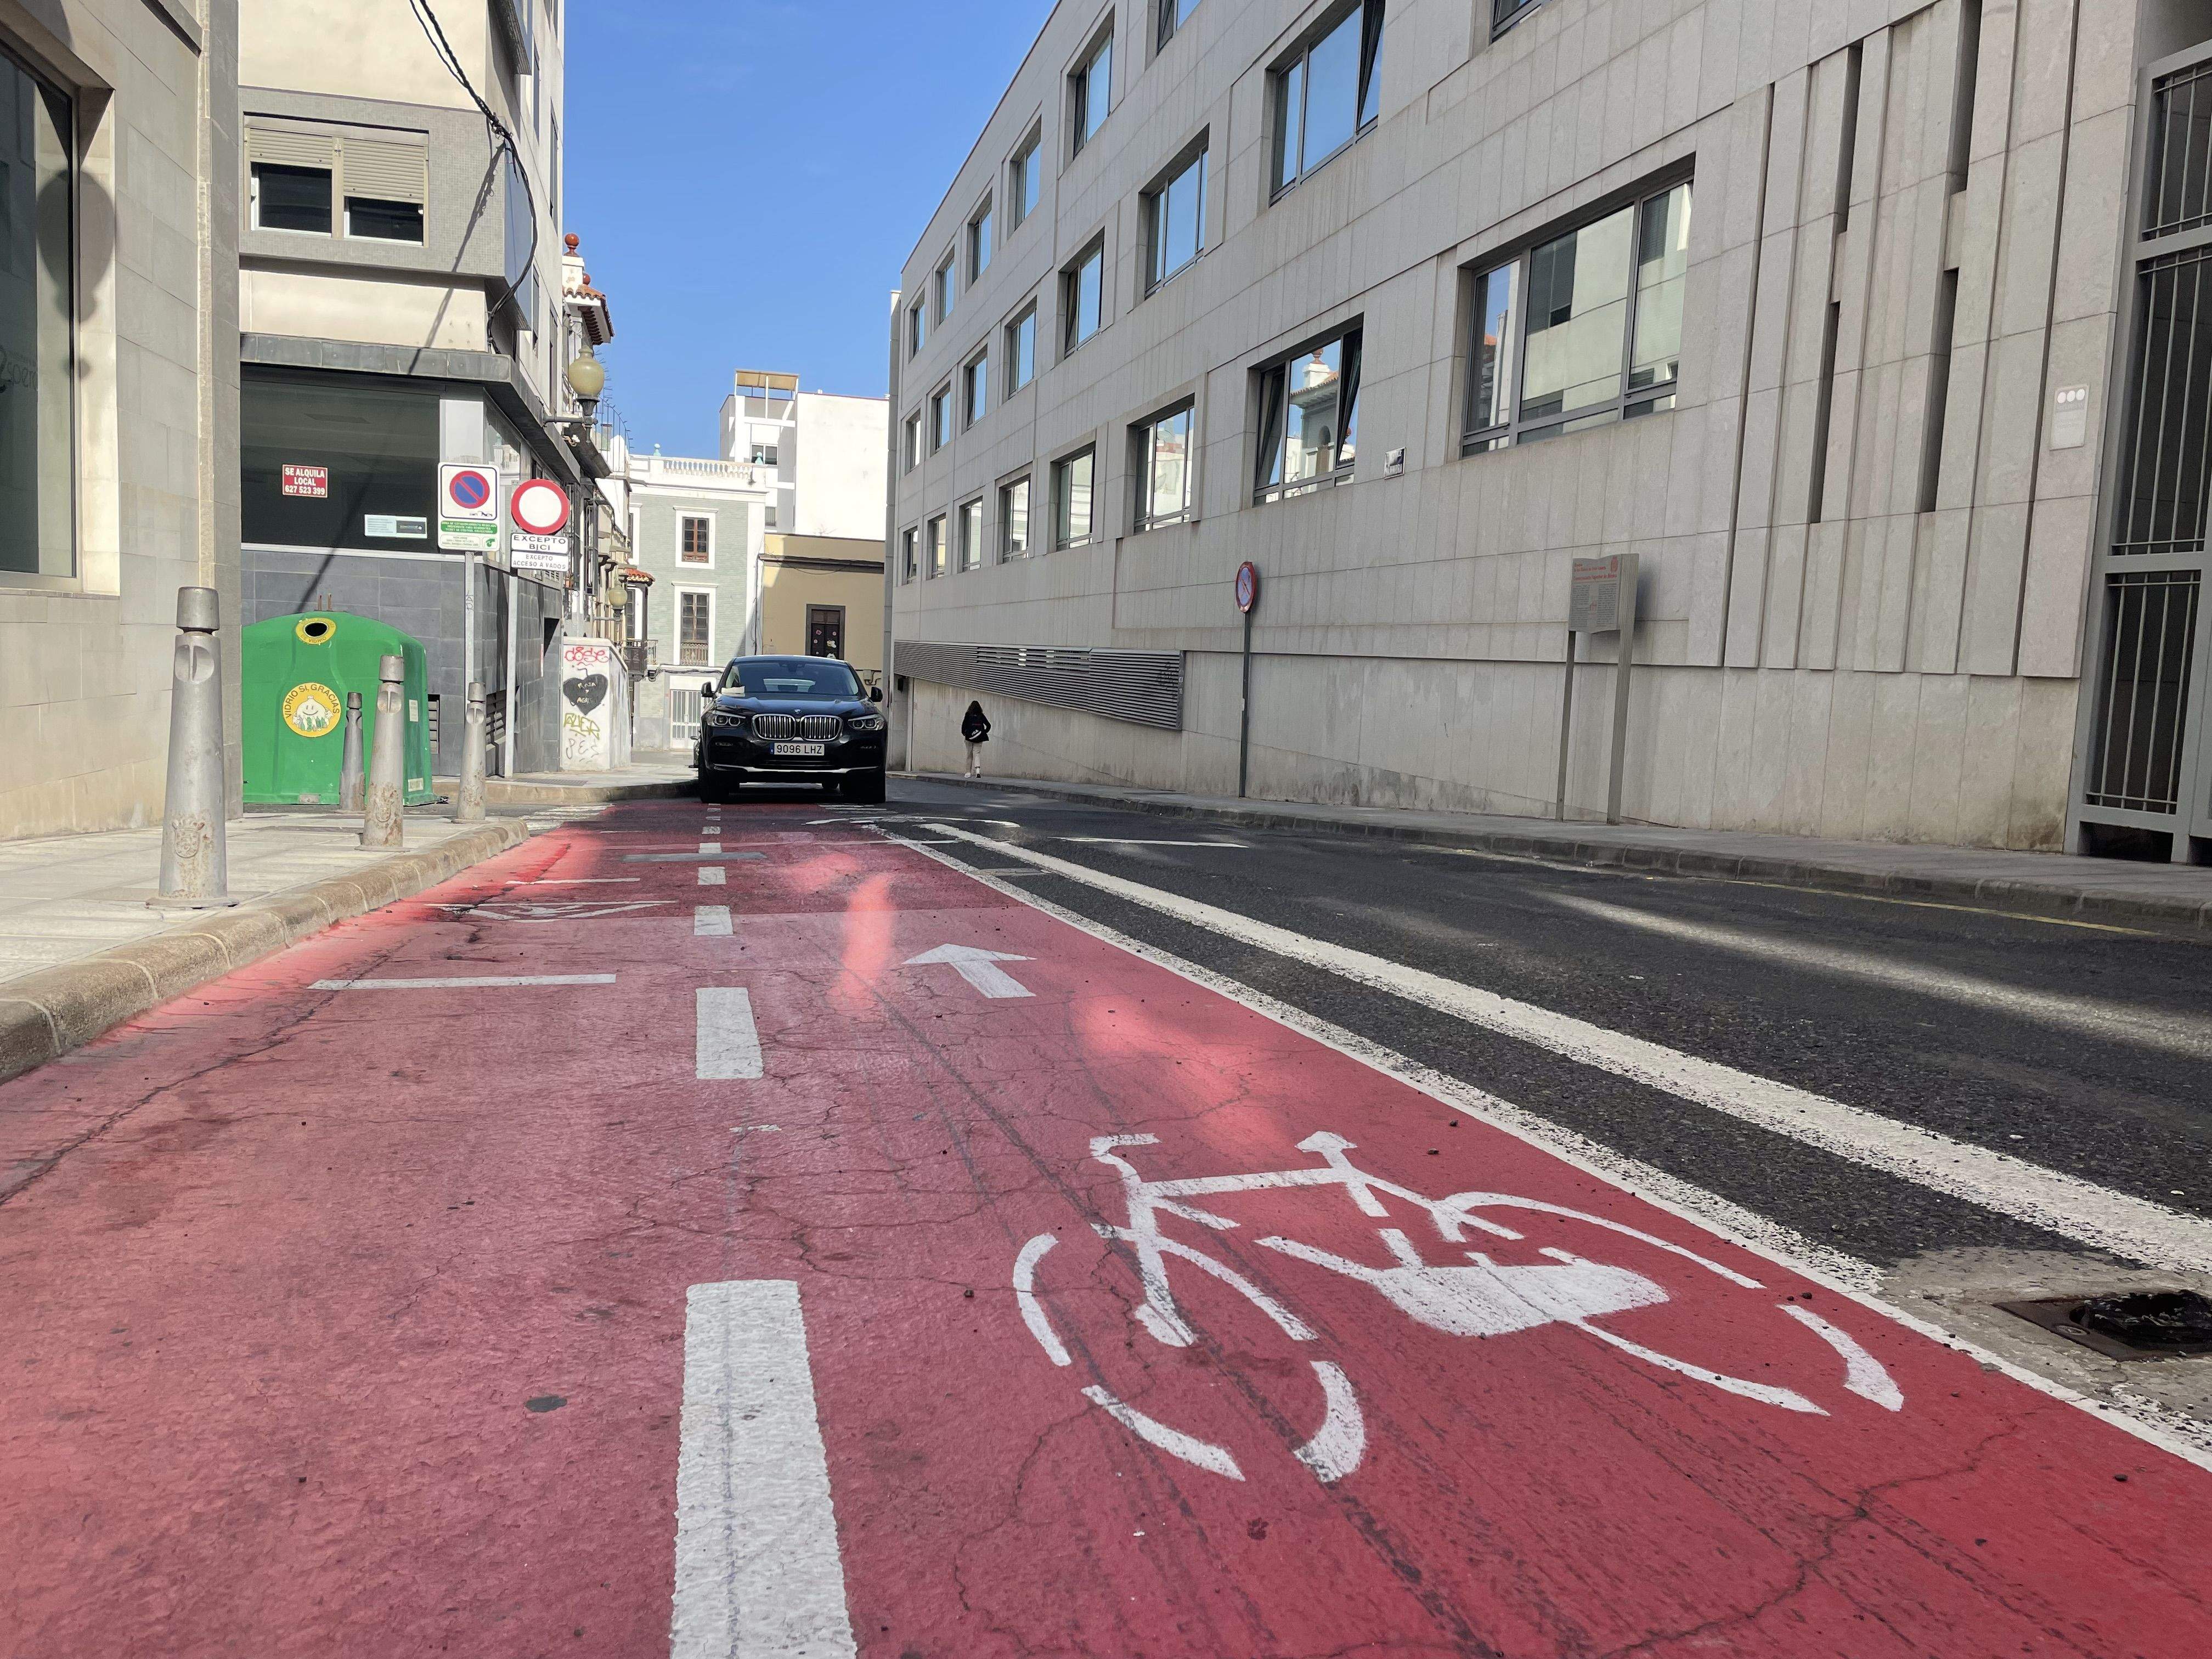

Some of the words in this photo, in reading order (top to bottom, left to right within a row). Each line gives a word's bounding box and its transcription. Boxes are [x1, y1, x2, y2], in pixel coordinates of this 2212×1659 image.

[285, 467, 295, 476] SE
[296, 468, 325, 478] ALQUILA
[294, 477, 316, 486] LOCAL
[285, 485, 298, 493] 627
[299, 486, 312, 494] 523
[313, 487, 325, 495] 399
[514, 535, 566, 544] EXCEPTO
[285, 690, 298, 718] VIDRIO
[311, 684, 340, 714] GRACIAS
[776, 744, 801, 753] 9096
[804, 745, 822, 754] LHZ
